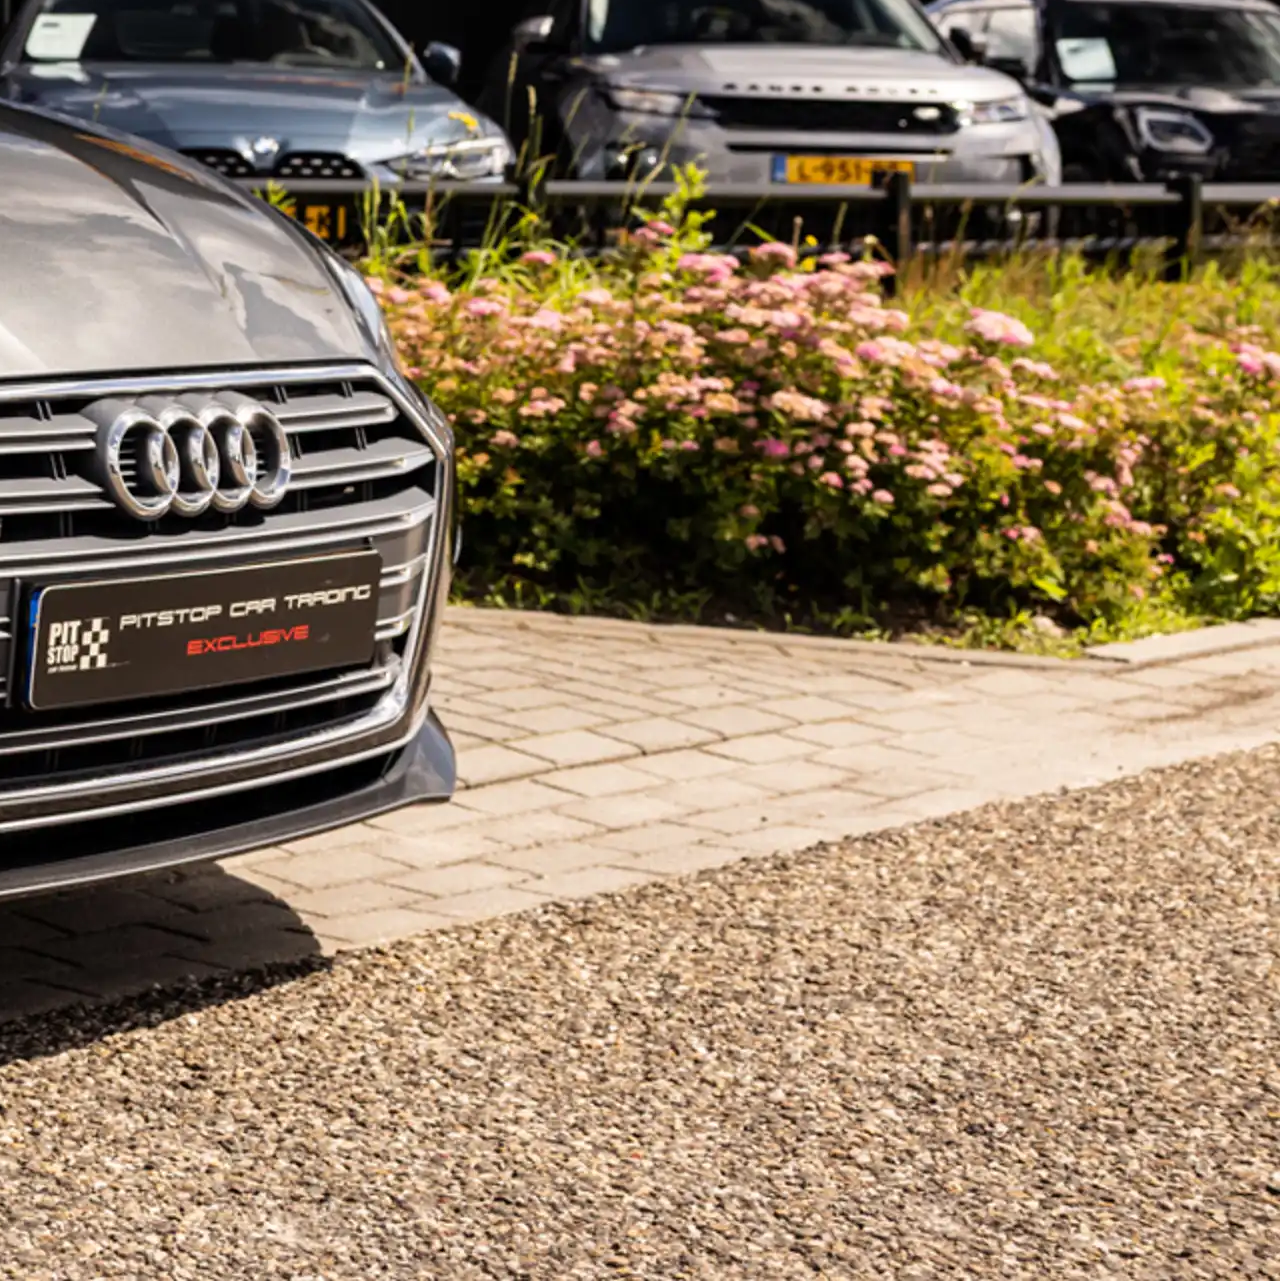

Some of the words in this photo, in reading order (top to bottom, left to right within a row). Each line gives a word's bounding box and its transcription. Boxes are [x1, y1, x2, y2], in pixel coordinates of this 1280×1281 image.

[119, 604, 223, 631] PITSTOP
[229, 597, 277, 619] CAR
[283, 584, 372, 610] TRADING
[48, 619, 82, 647] PIT
[186, 623, 310, 657] EXCLUSIVE
[46, 644, 80, 666] STOP
